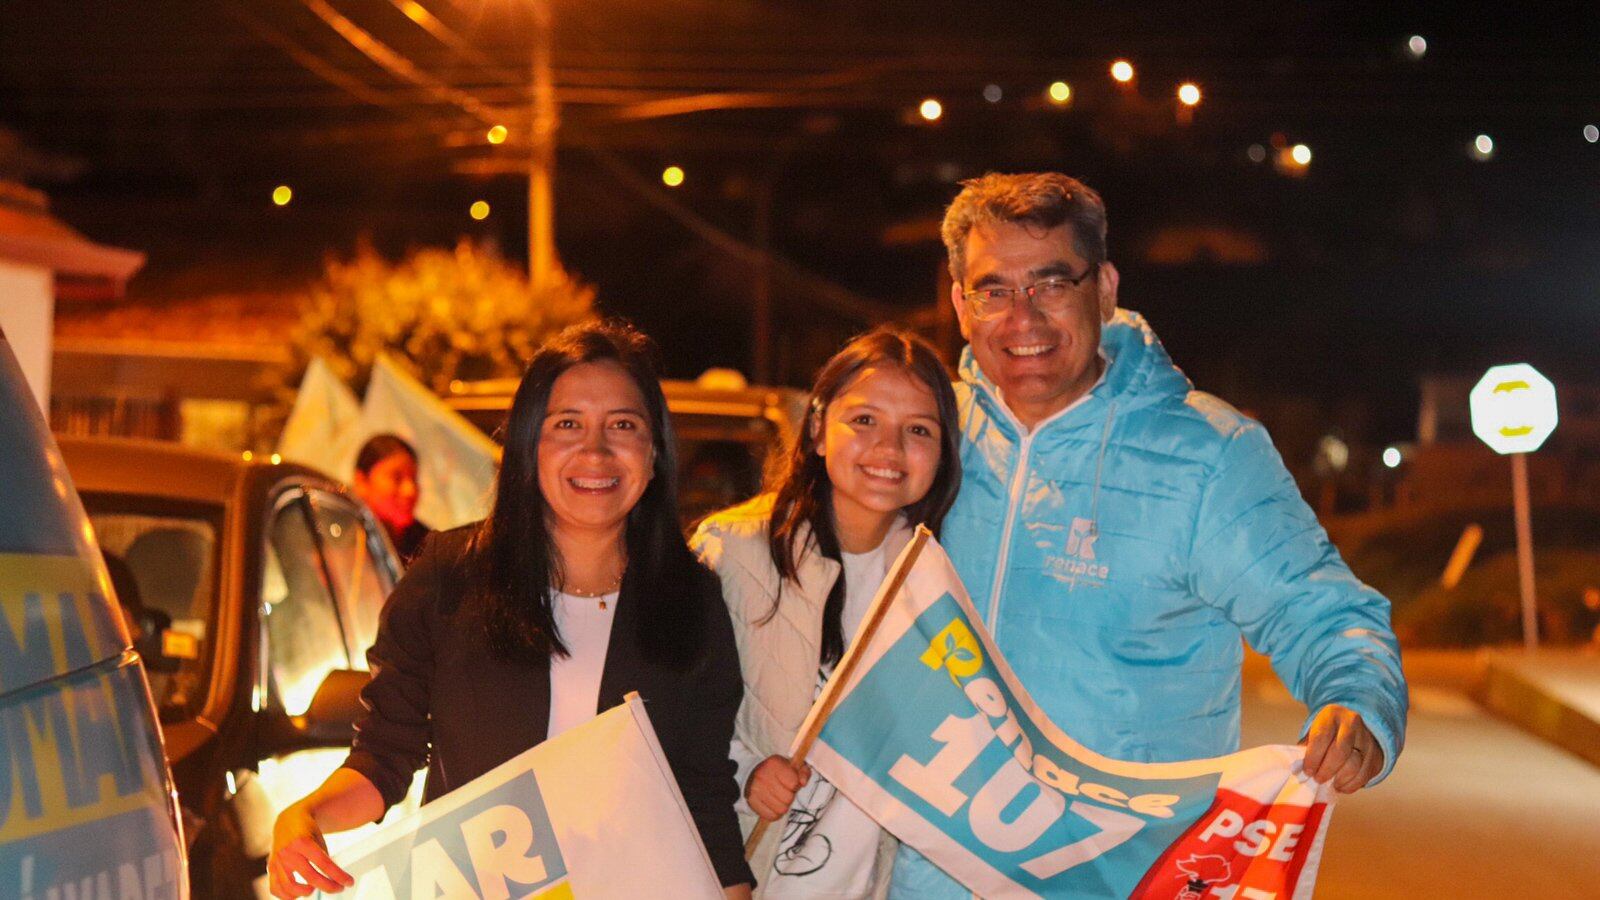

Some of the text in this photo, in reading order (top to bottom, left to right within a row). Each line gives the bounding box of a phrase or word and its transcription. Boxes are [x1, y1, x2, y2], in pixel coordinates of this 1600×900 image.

[888, 711, 1147, 880] 107
[918, 616, 1181, 819] Renace
[1198, 808, 1304, 862] PSE
